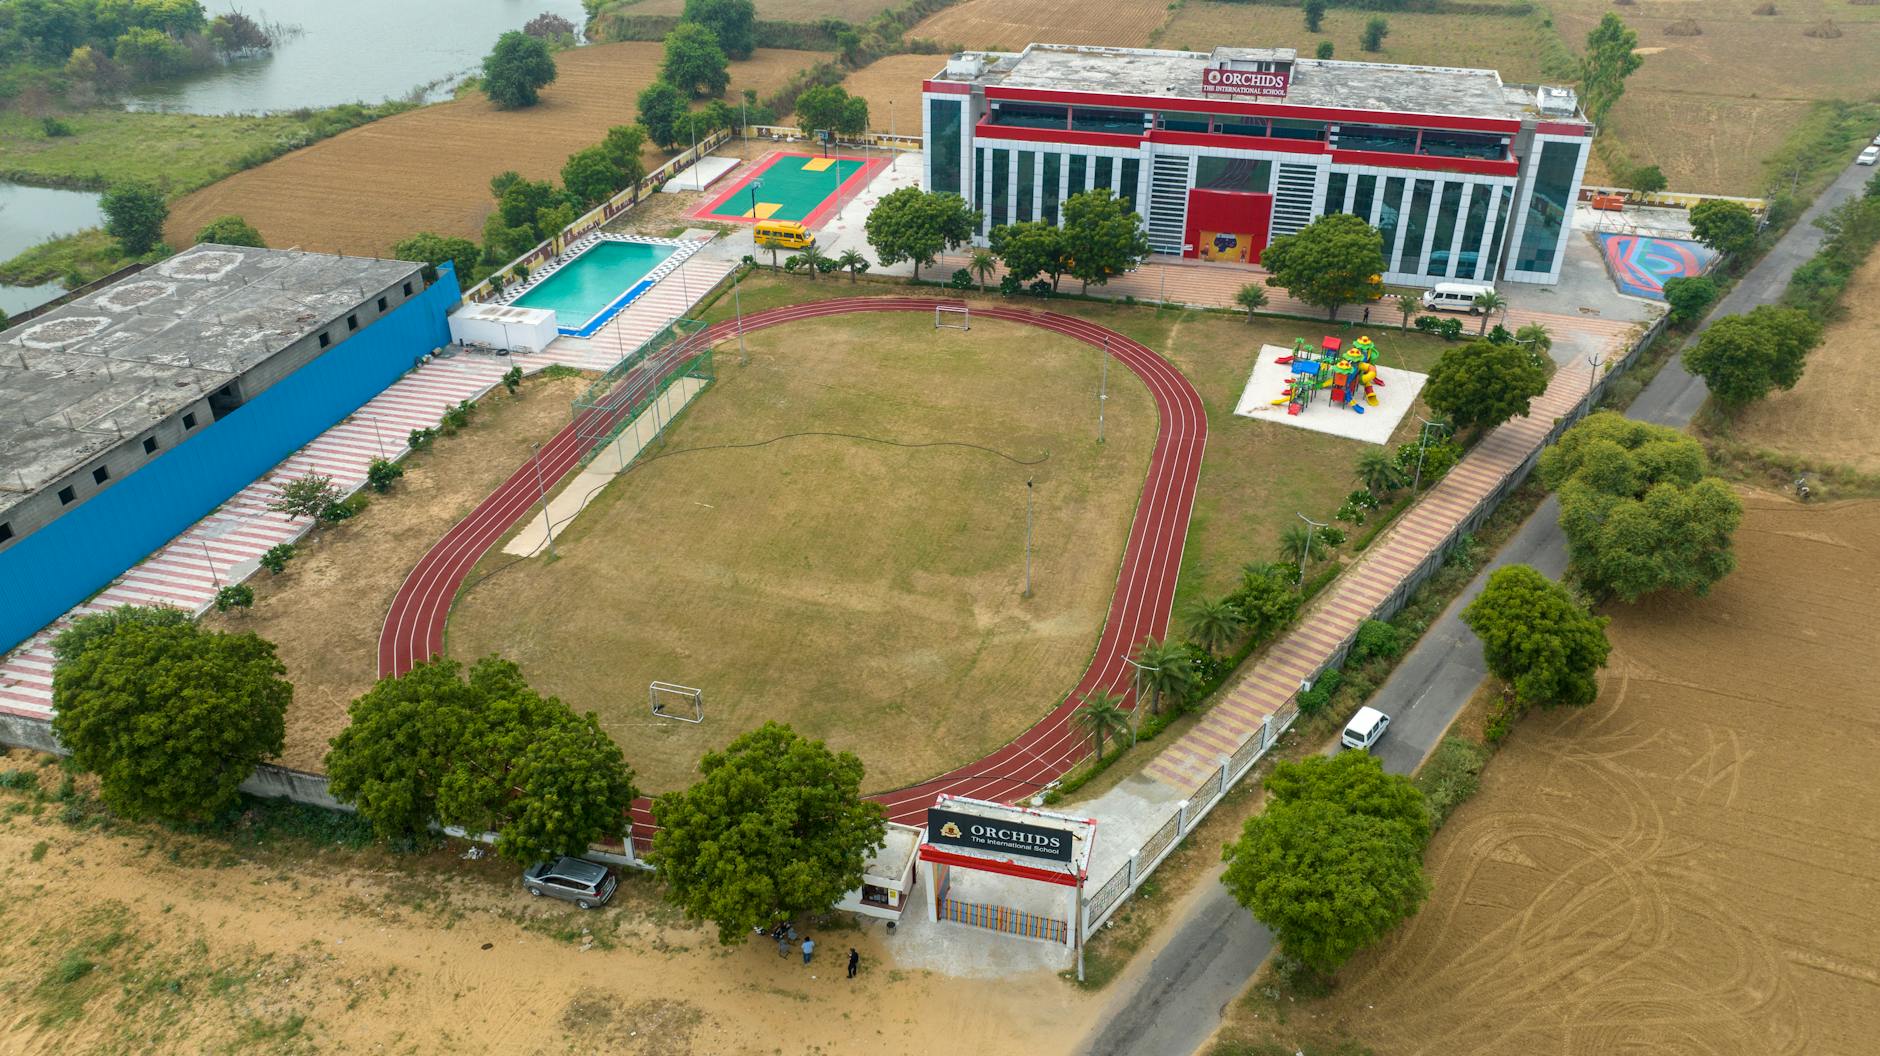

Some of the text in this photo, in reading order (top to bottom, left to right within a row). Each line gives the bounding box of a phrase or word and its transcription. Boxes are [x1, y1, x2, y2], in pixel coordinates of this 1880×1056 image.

[1223, 73, 1284, 87] ORCHIDS
[1216, 86, 1261, 94] INTERNATIONAL
[971, 825, 1060, 847] ORCHIDS
[987, 838, 1032, 850] International
[1034, 845, 1059, 854] School
